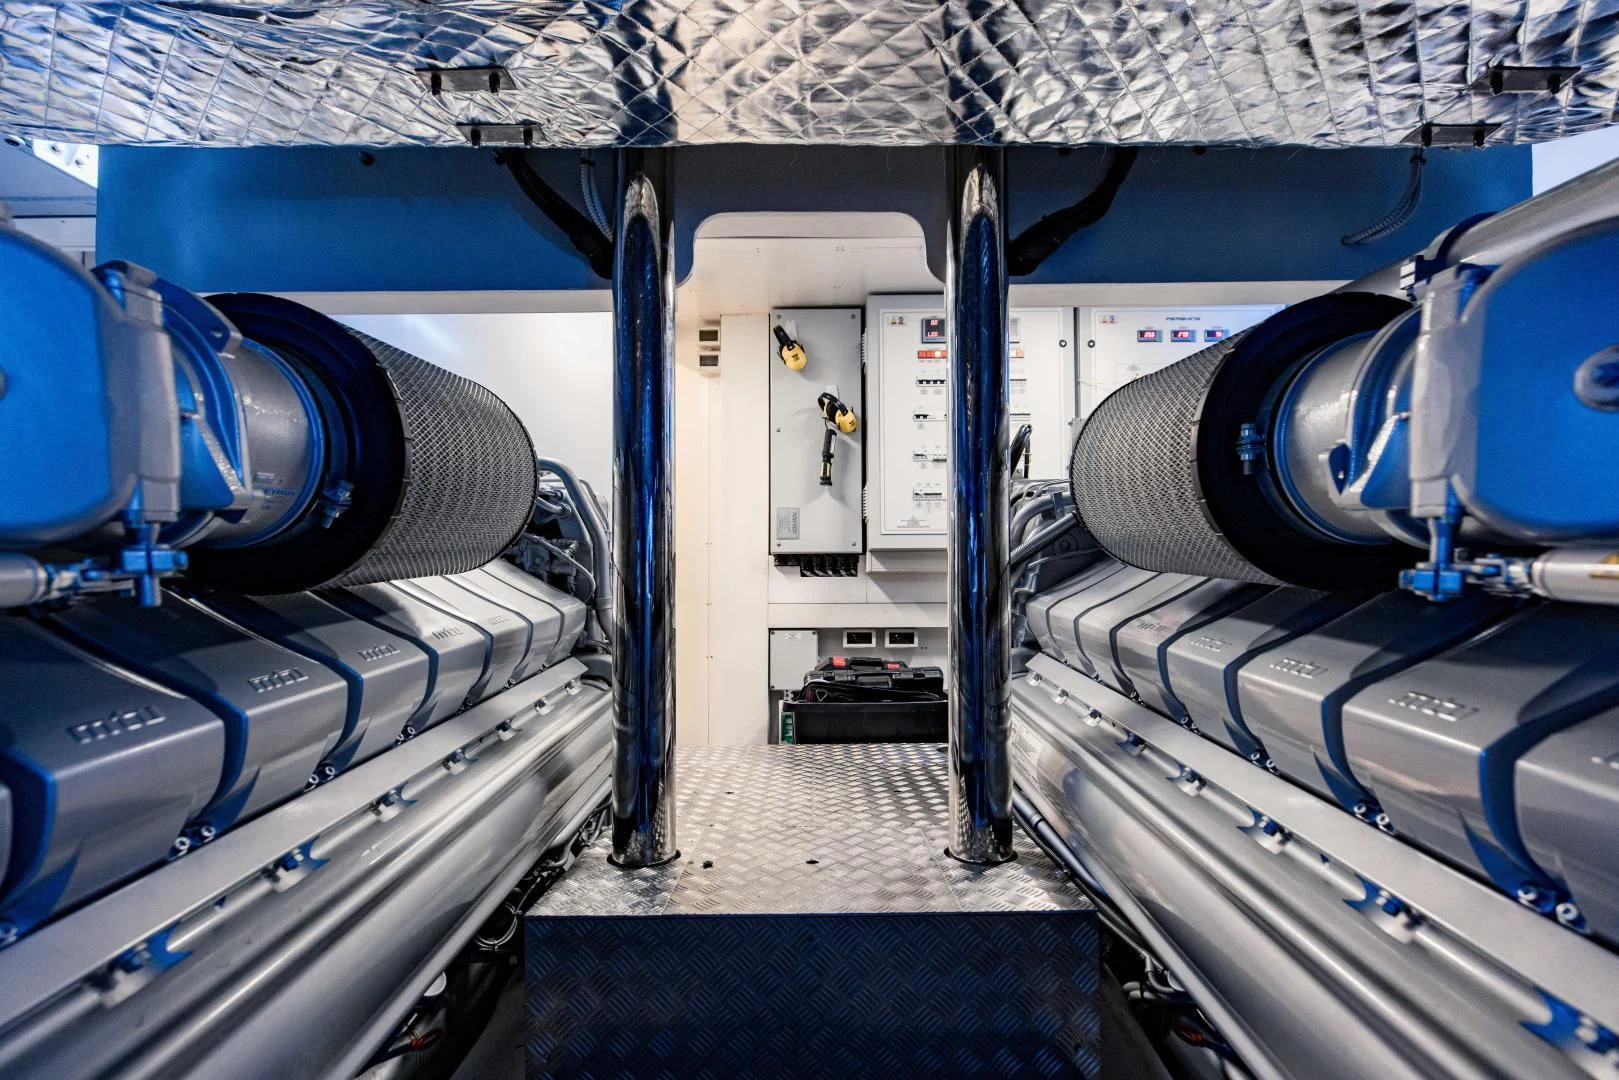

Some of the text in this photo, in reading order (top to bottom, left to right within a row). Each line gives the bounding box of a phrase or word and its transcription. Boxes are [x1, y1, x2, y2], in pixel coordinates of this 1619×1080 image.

[358, 642, 400, 662] mtu
[248, 668, 309, 693] mtu
[68, 704, 167, 744] mtu
